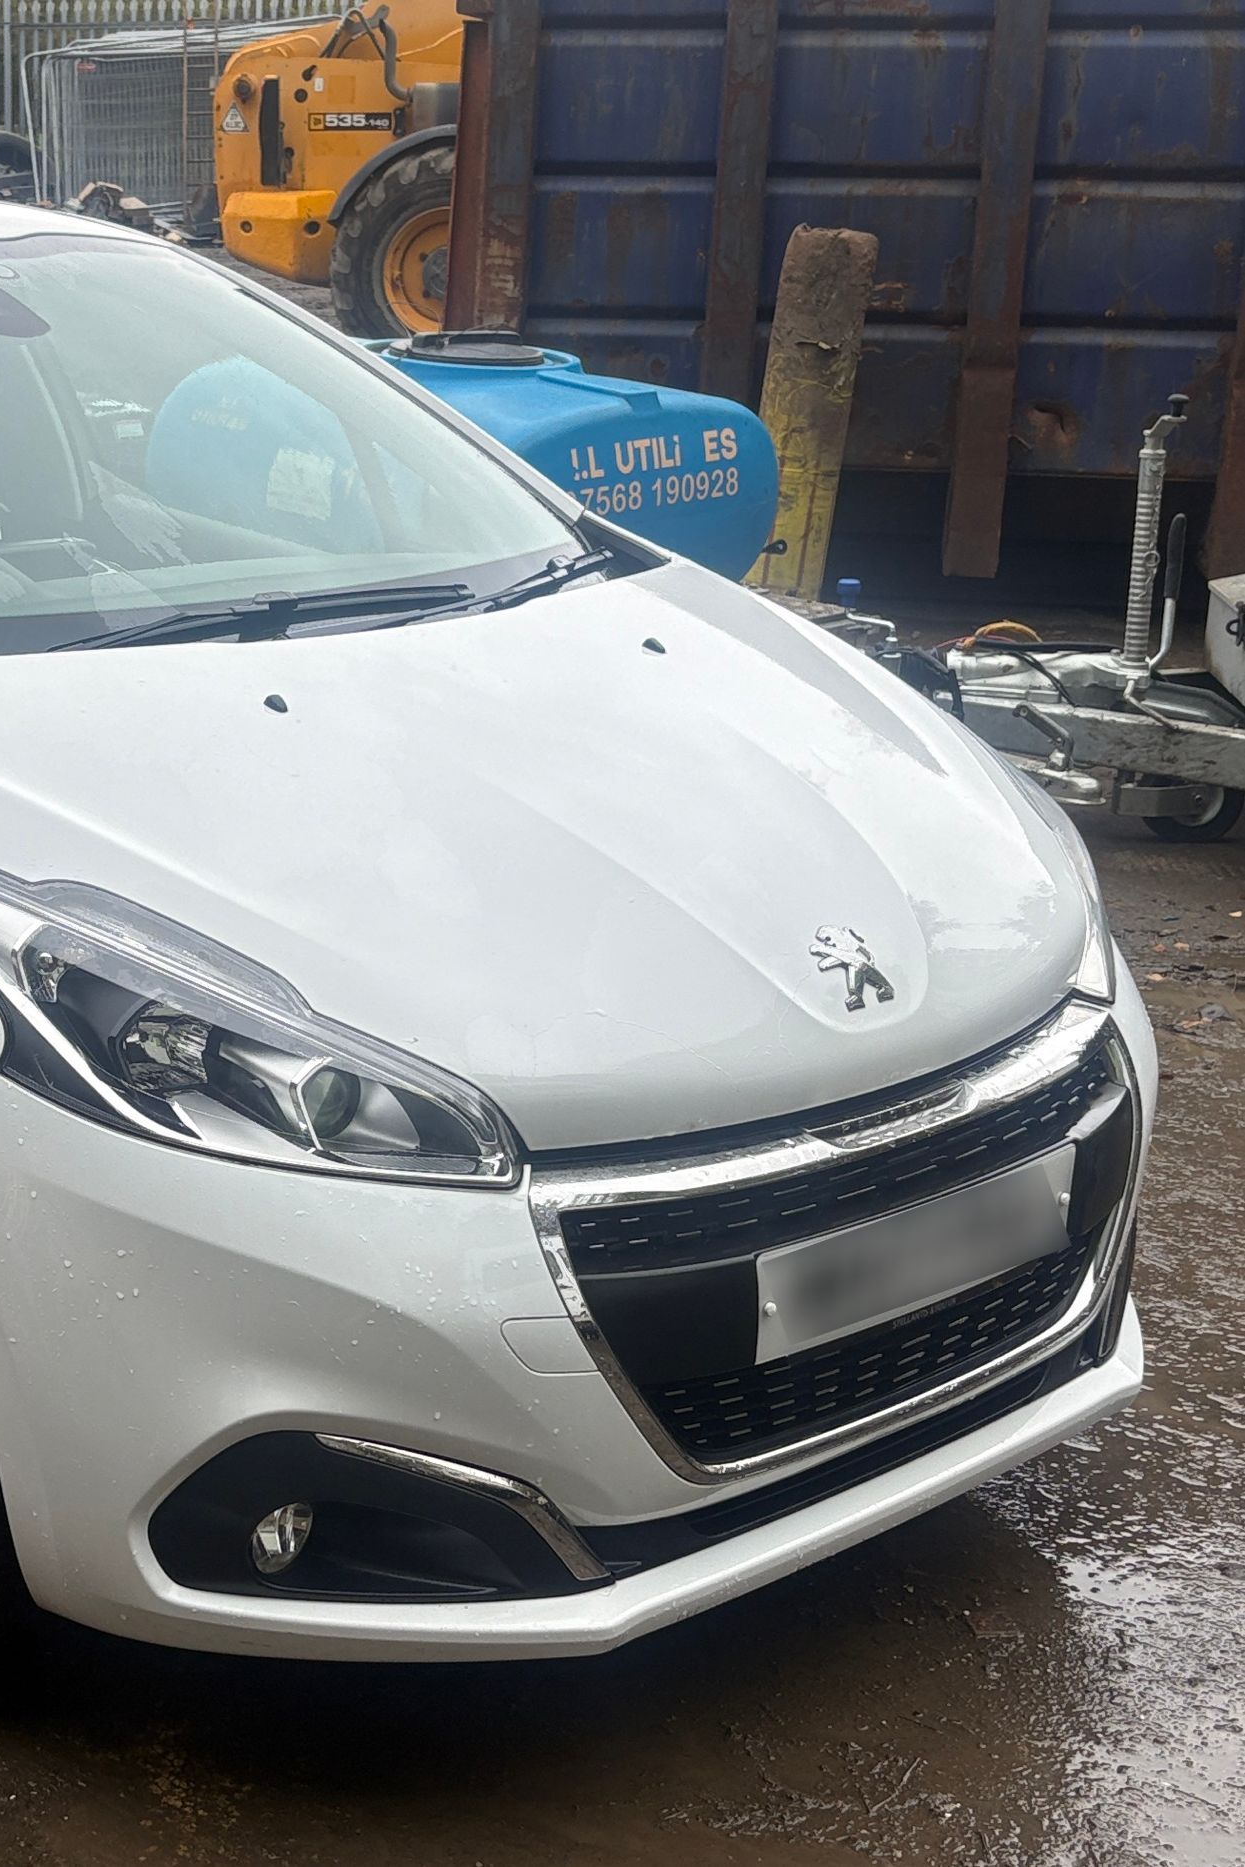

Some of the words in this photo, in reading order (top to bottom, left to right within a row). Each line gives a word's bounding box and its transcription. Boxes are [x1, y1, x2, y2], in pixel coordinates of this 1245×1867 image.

[567, 480, 643, 516] 7568
[651, 466, 740, 507] 190928
[841, 1095, 940, 1134] PEUGEO
